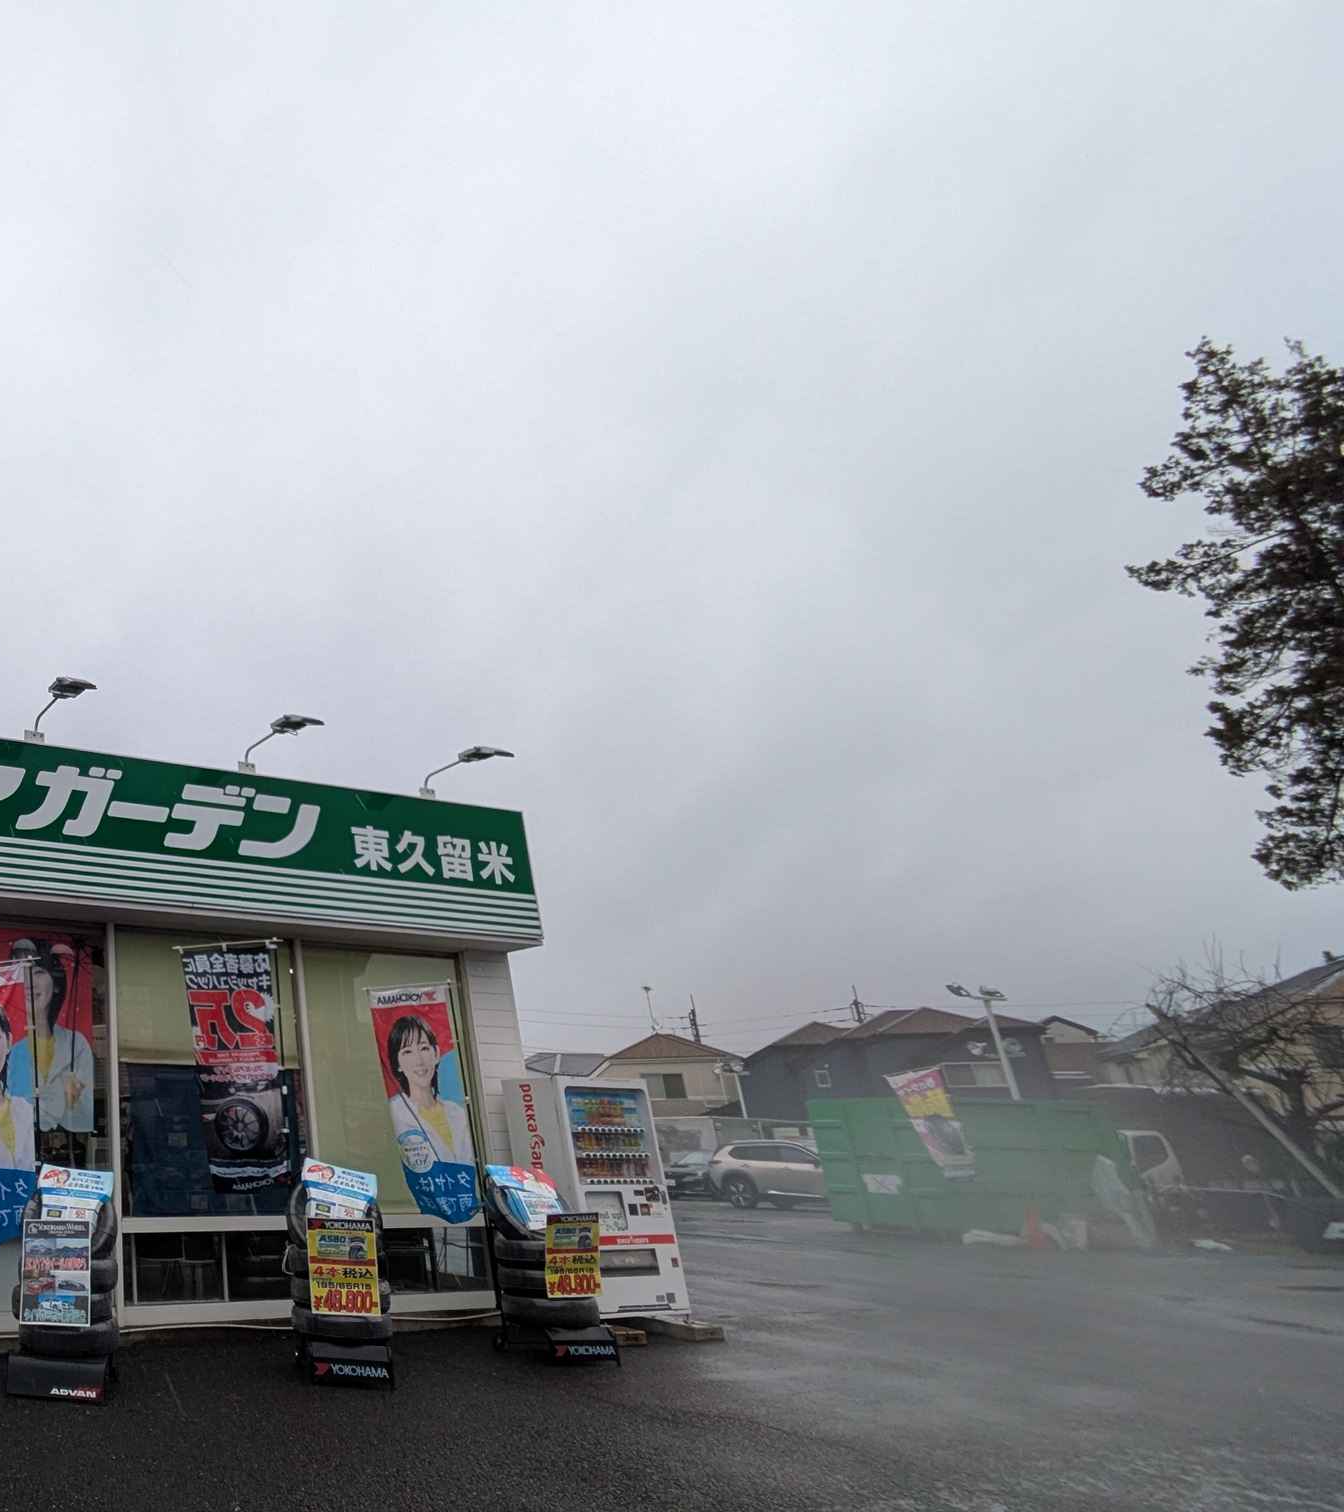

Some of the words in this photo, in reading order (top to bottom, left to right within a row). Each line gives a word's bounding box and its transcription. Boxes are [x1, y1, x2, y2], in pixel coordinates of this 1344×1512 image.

[350, 825, 516, 885] 東久留米
[324, 1219, 372, 1231] YOKOHAMA
[567, 1345, 616, 1356] YOKOHAMA
[330, 1361, 389, 1378] YOKOHAMA
[49, 1387, 96, 1399] ADVAN
